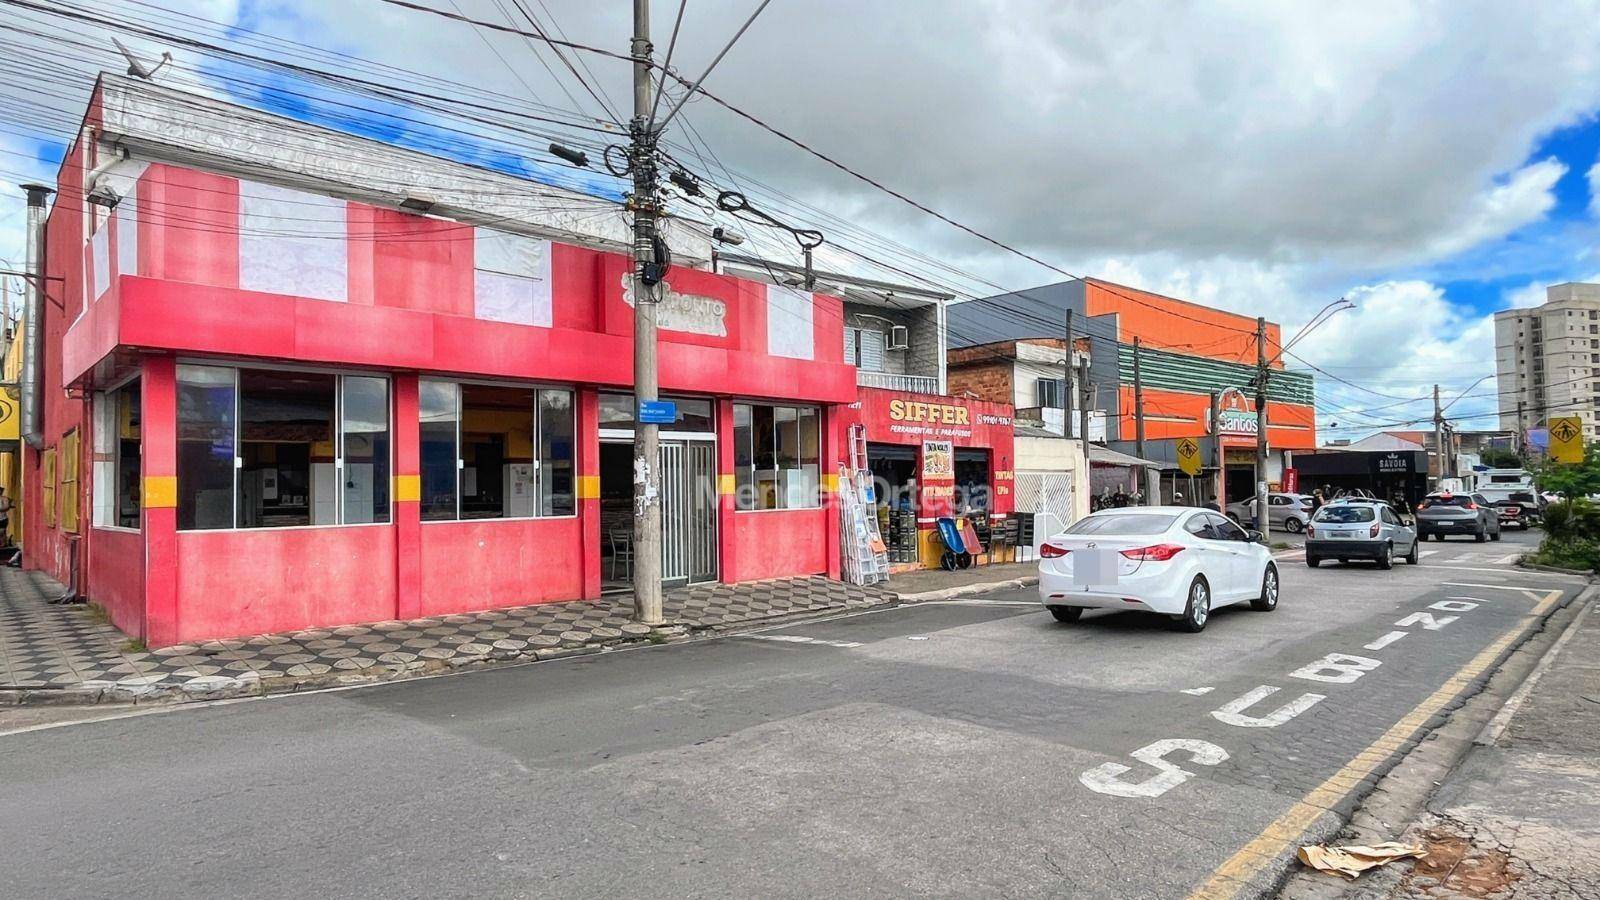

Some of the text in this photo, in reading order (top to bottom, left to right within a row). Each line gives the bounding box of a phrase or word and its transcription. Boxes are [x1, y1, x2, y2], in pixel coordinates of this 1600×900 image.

[889, 400, 970, 425] SIFFER
[890, 425, 933, 435] FERRAMENTAS
[1379, 459, 1407, 468] SAVOIA
